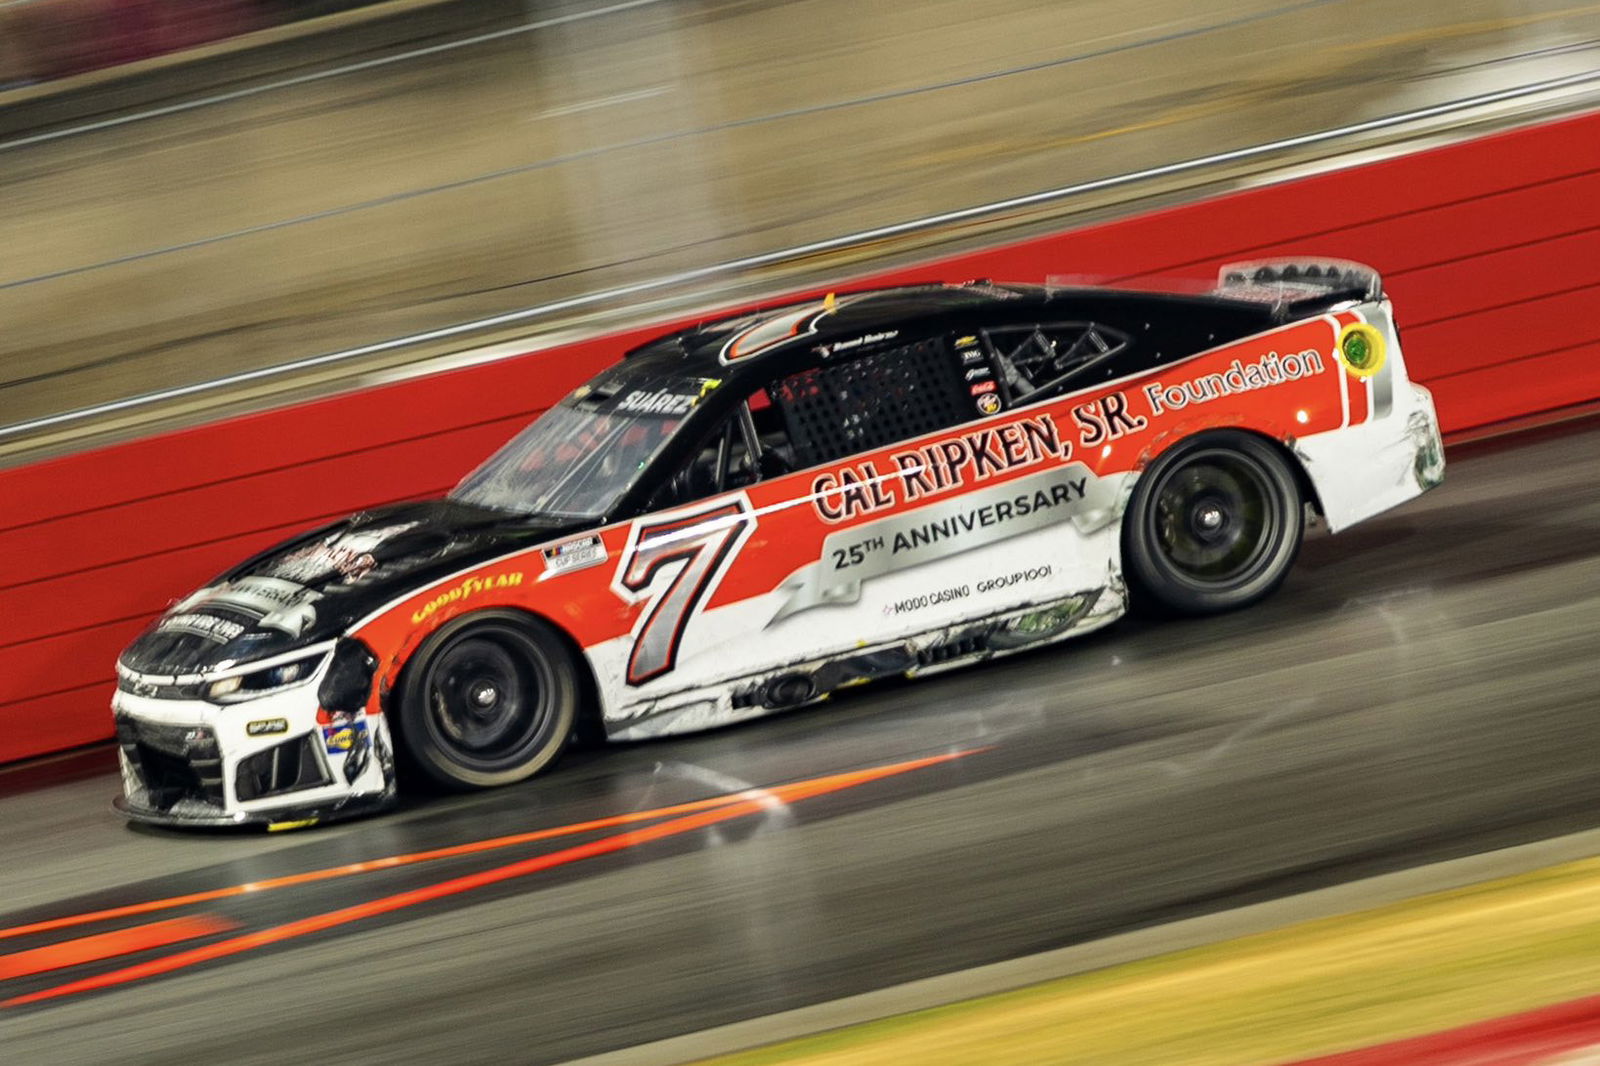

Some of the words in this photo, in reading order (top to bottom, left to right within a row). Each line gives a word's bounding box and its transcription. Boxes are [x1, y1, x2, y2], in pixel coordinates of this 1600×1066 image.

[812, 461, 895, 523] CAL
[891, 414, 1073, 502] RIPKEN,
[1071, 391, 1149, 448] SR.
[1143, 349, 1326, 417] Foundation
[832, 535, 885, 570] 25TH
[891, 476, 1088, 556] ANNIVERSARY
[411, 571, 524, 624] GOODYEAR
[613, 493, 757, 688] 7
[894, 595, 929, 615] MODO
[929, 584, 970, 606] CASINO
[976, 565, 1053, 593] GROUP1001
